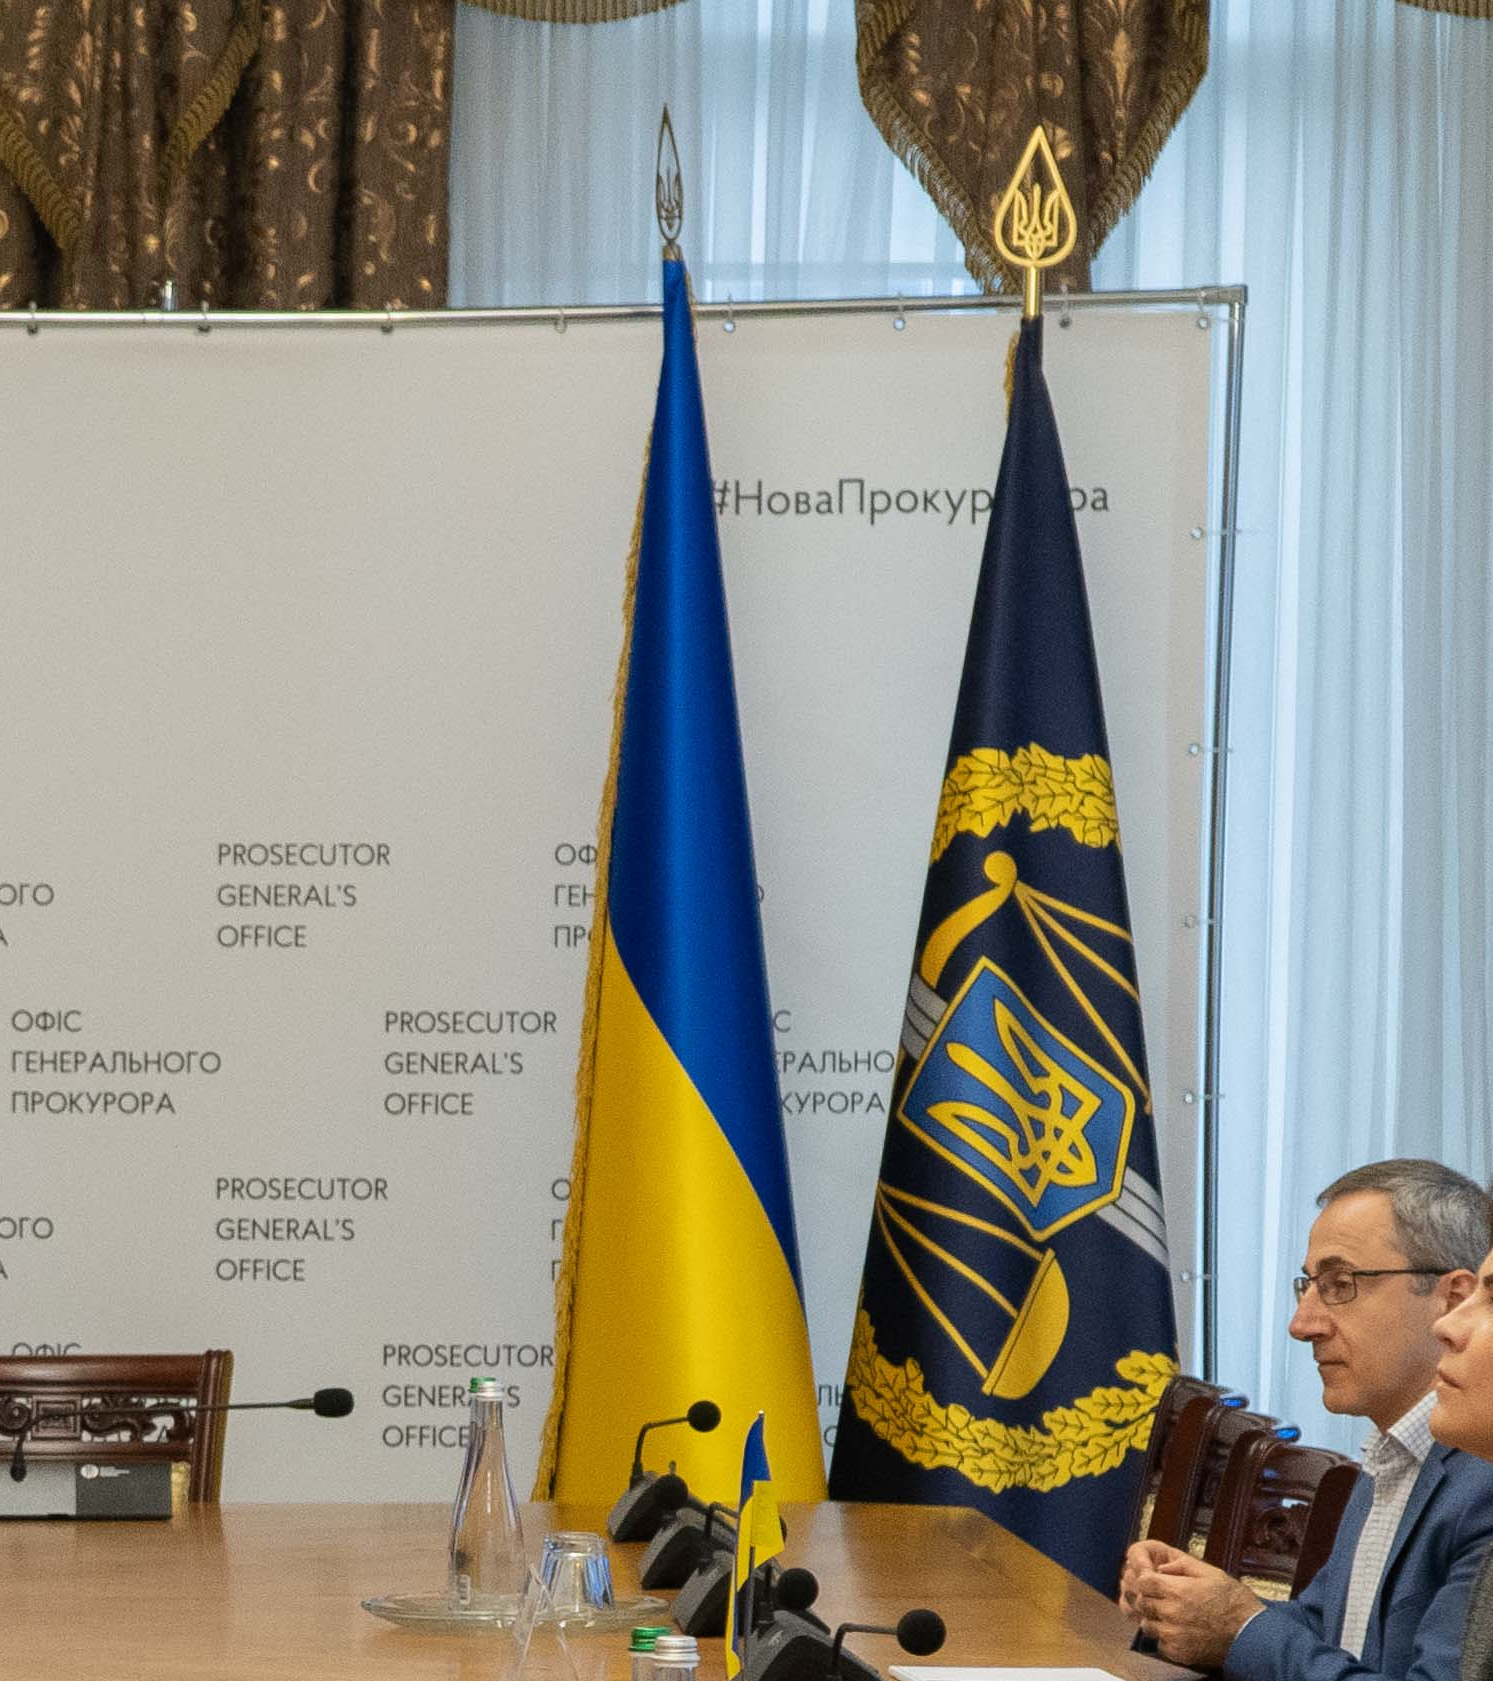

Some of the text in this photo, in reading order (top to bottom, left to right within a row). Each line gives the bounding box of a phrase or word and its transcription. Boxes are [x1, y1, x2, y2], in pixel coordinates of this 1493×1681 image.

[217, 842, 391, 867] PROSECUTOR
[216, 883, 358, 908] GENERAL'S
[216, 924, 307, 949] OFFICE
[10, 1008, 82, 1034] ОФІС
[384, 1010, 558, 1035] PROSECUTOR
[10, 1049, 222, 1075] ГЕНЕРАЛЬНОГО
[383, 1050, 524, 1076] GENERAL'S
[10, 1090, 176, 1116] ПРОКУРОРА
[383, 1091, 474, 1117] OFFICE
[780, 1091, 886, 1116] КУРОРА
[215, 1176, 389, 1202] PROSECUTOR
[214, 1216, 356, 1242] GENERAL'S
[214, 1257, 306, 1283] OFFICE
[382, 1344, 555, 1368] PROSECUTOR
[382, 1424, 471, 1449] OFFICE
